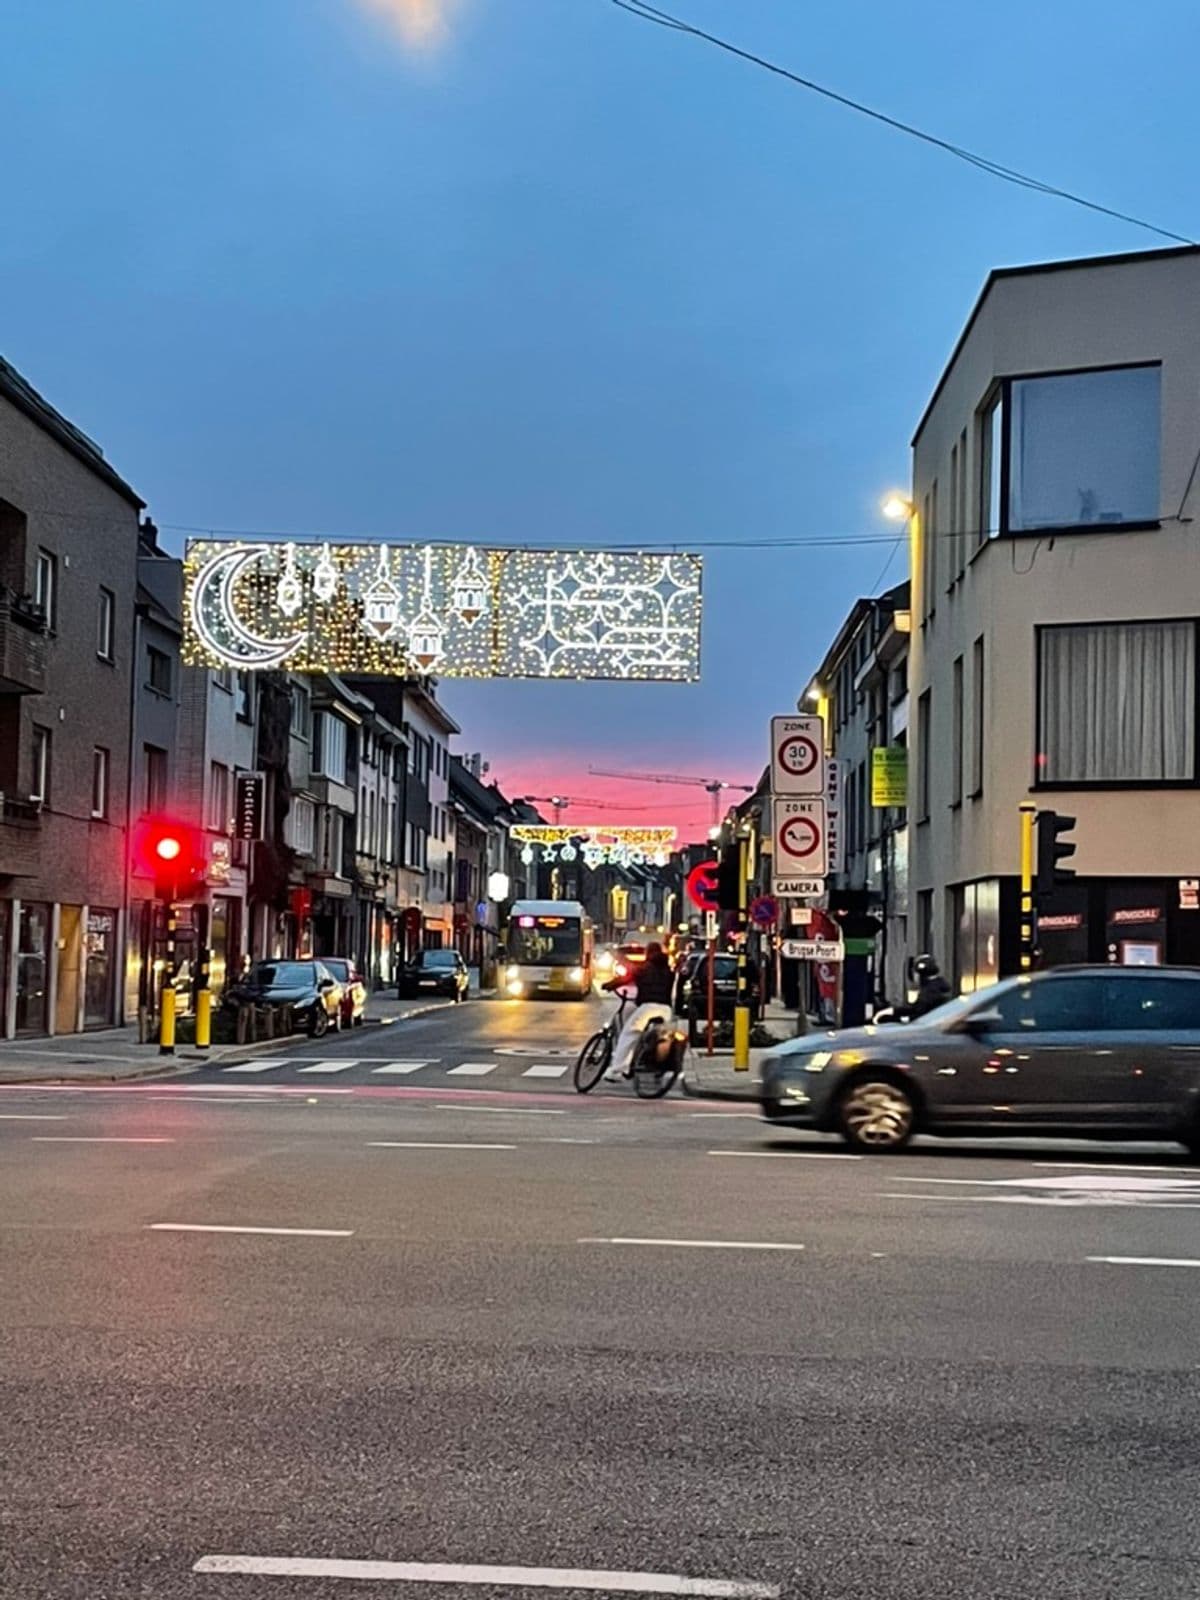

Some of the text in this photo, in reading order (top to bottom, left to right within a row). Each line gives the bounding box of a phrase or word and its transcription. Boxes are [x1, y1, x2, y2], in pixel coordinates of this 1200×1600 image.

[784, 723, 811, 731] ZONE
[789, 746, 807, 758] 30
[785, 804, 813, 812] ZONE
[827, 811, 838, 869] WINKEL
[776, 883, 819, 893] CAMERA
[788, 943, 836, 957] Brugse Poort
